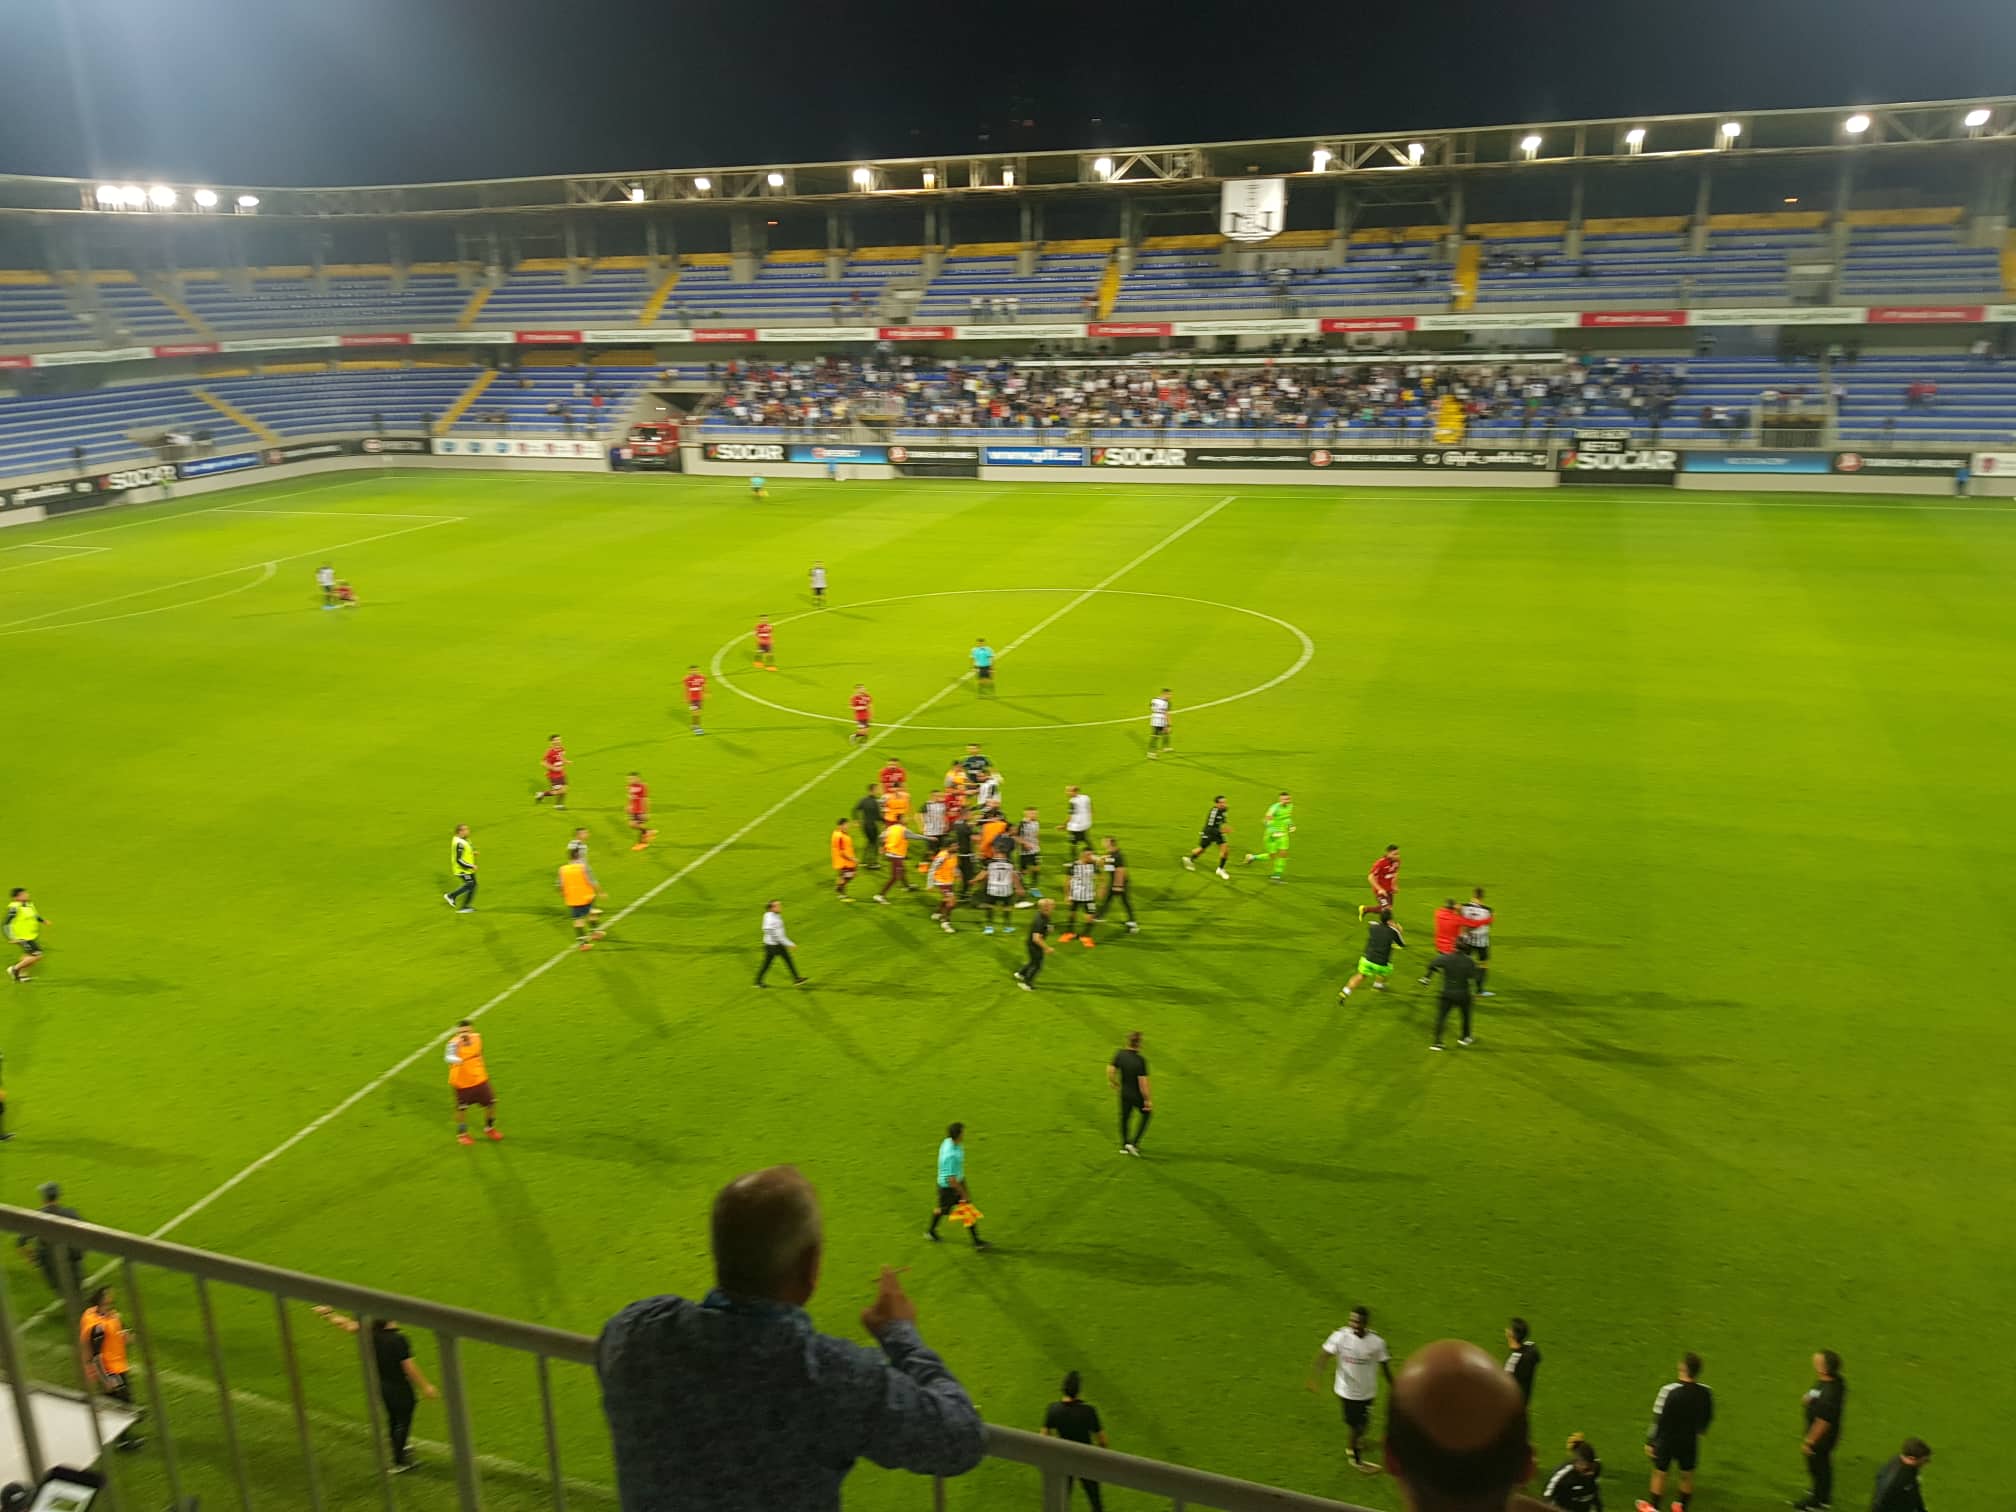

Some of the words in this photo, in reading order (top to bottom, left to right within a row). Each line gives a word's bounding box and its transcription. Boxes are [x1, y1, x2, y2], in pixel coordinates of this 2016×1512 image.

[717, 444, 785, 460] SOCAR
[1105, 448, 1186, 466] SOCAR
[1576, 449, 1677, 470] SOCAR
